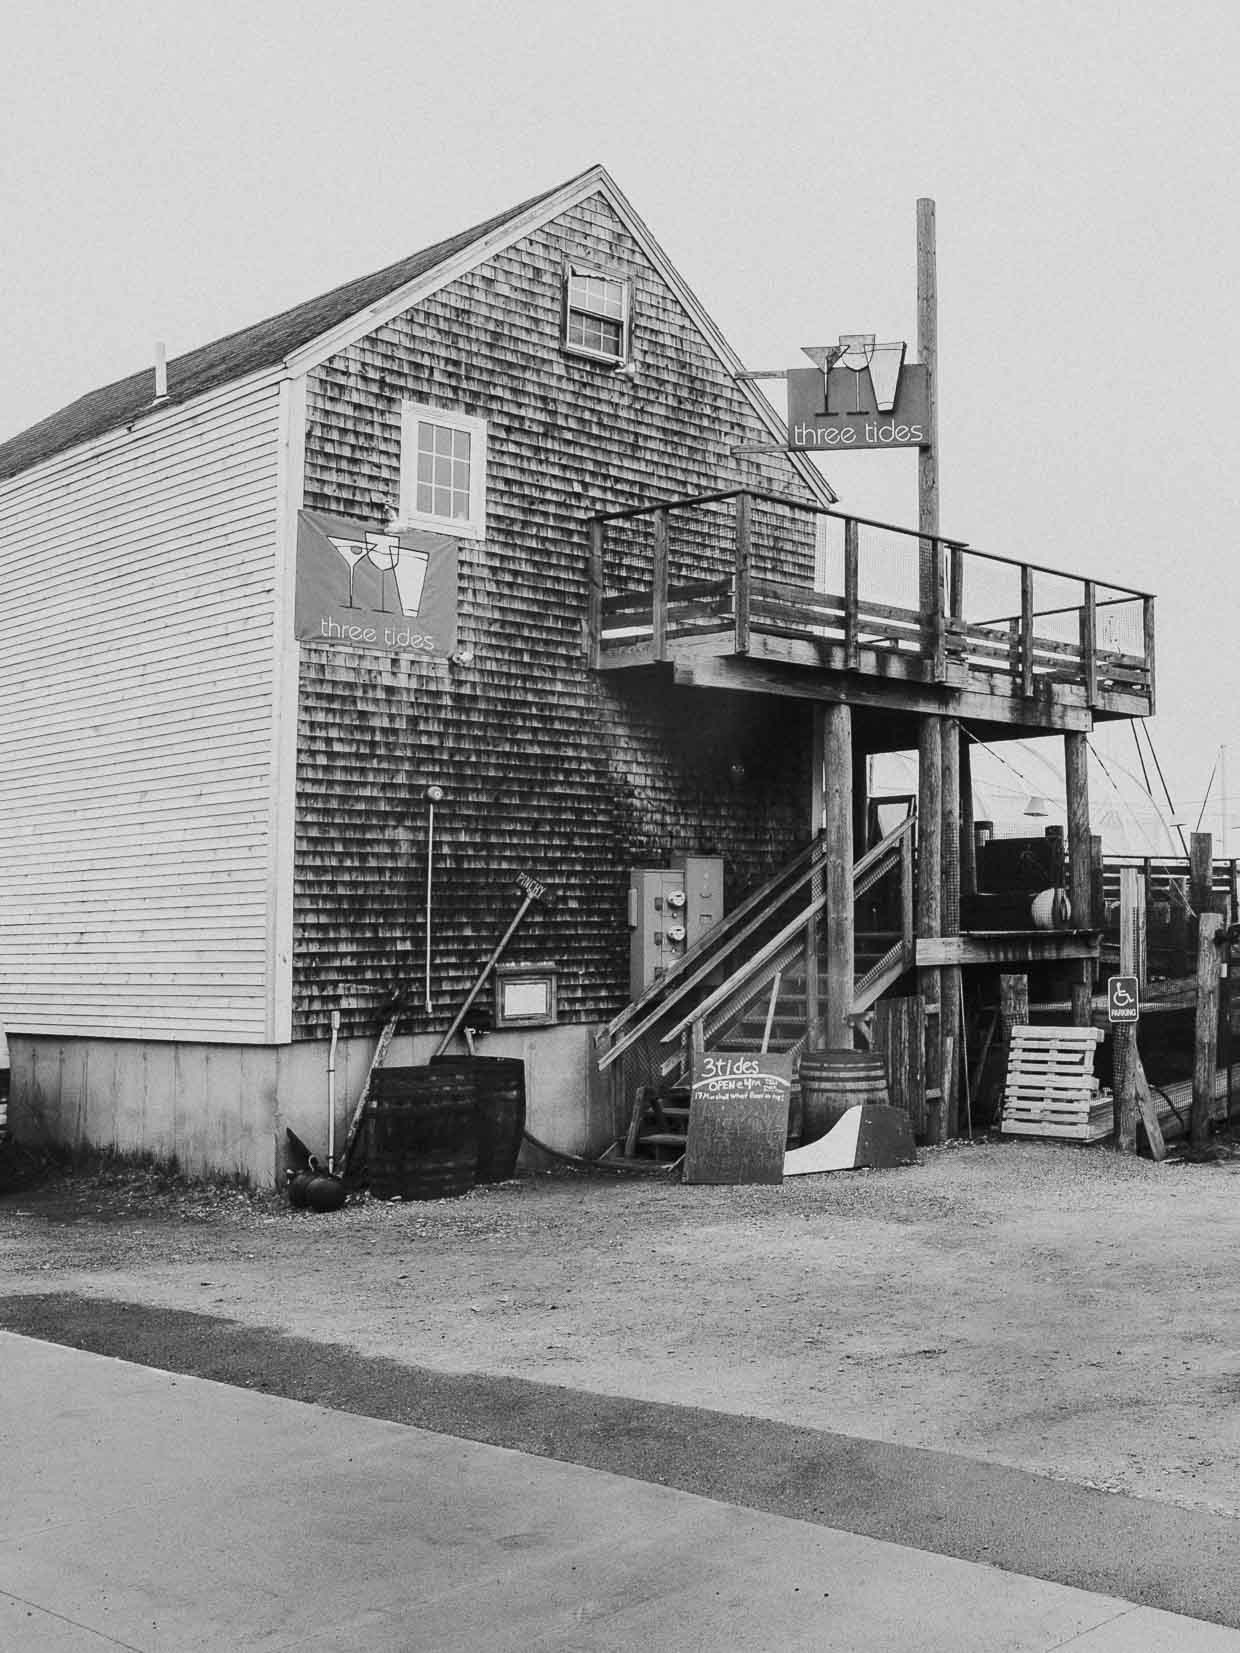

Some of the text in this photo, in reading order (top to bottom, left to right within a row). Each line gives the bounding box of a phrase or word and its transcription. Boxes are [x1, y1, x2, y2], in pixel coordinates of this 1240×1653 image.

[794, 418, 923, 445] three tides
[320, 615, 434, 650] three tides
[1111, 1008, 1137, 1017] PARKING
[709, 1080, 736, 1092] OPEN
